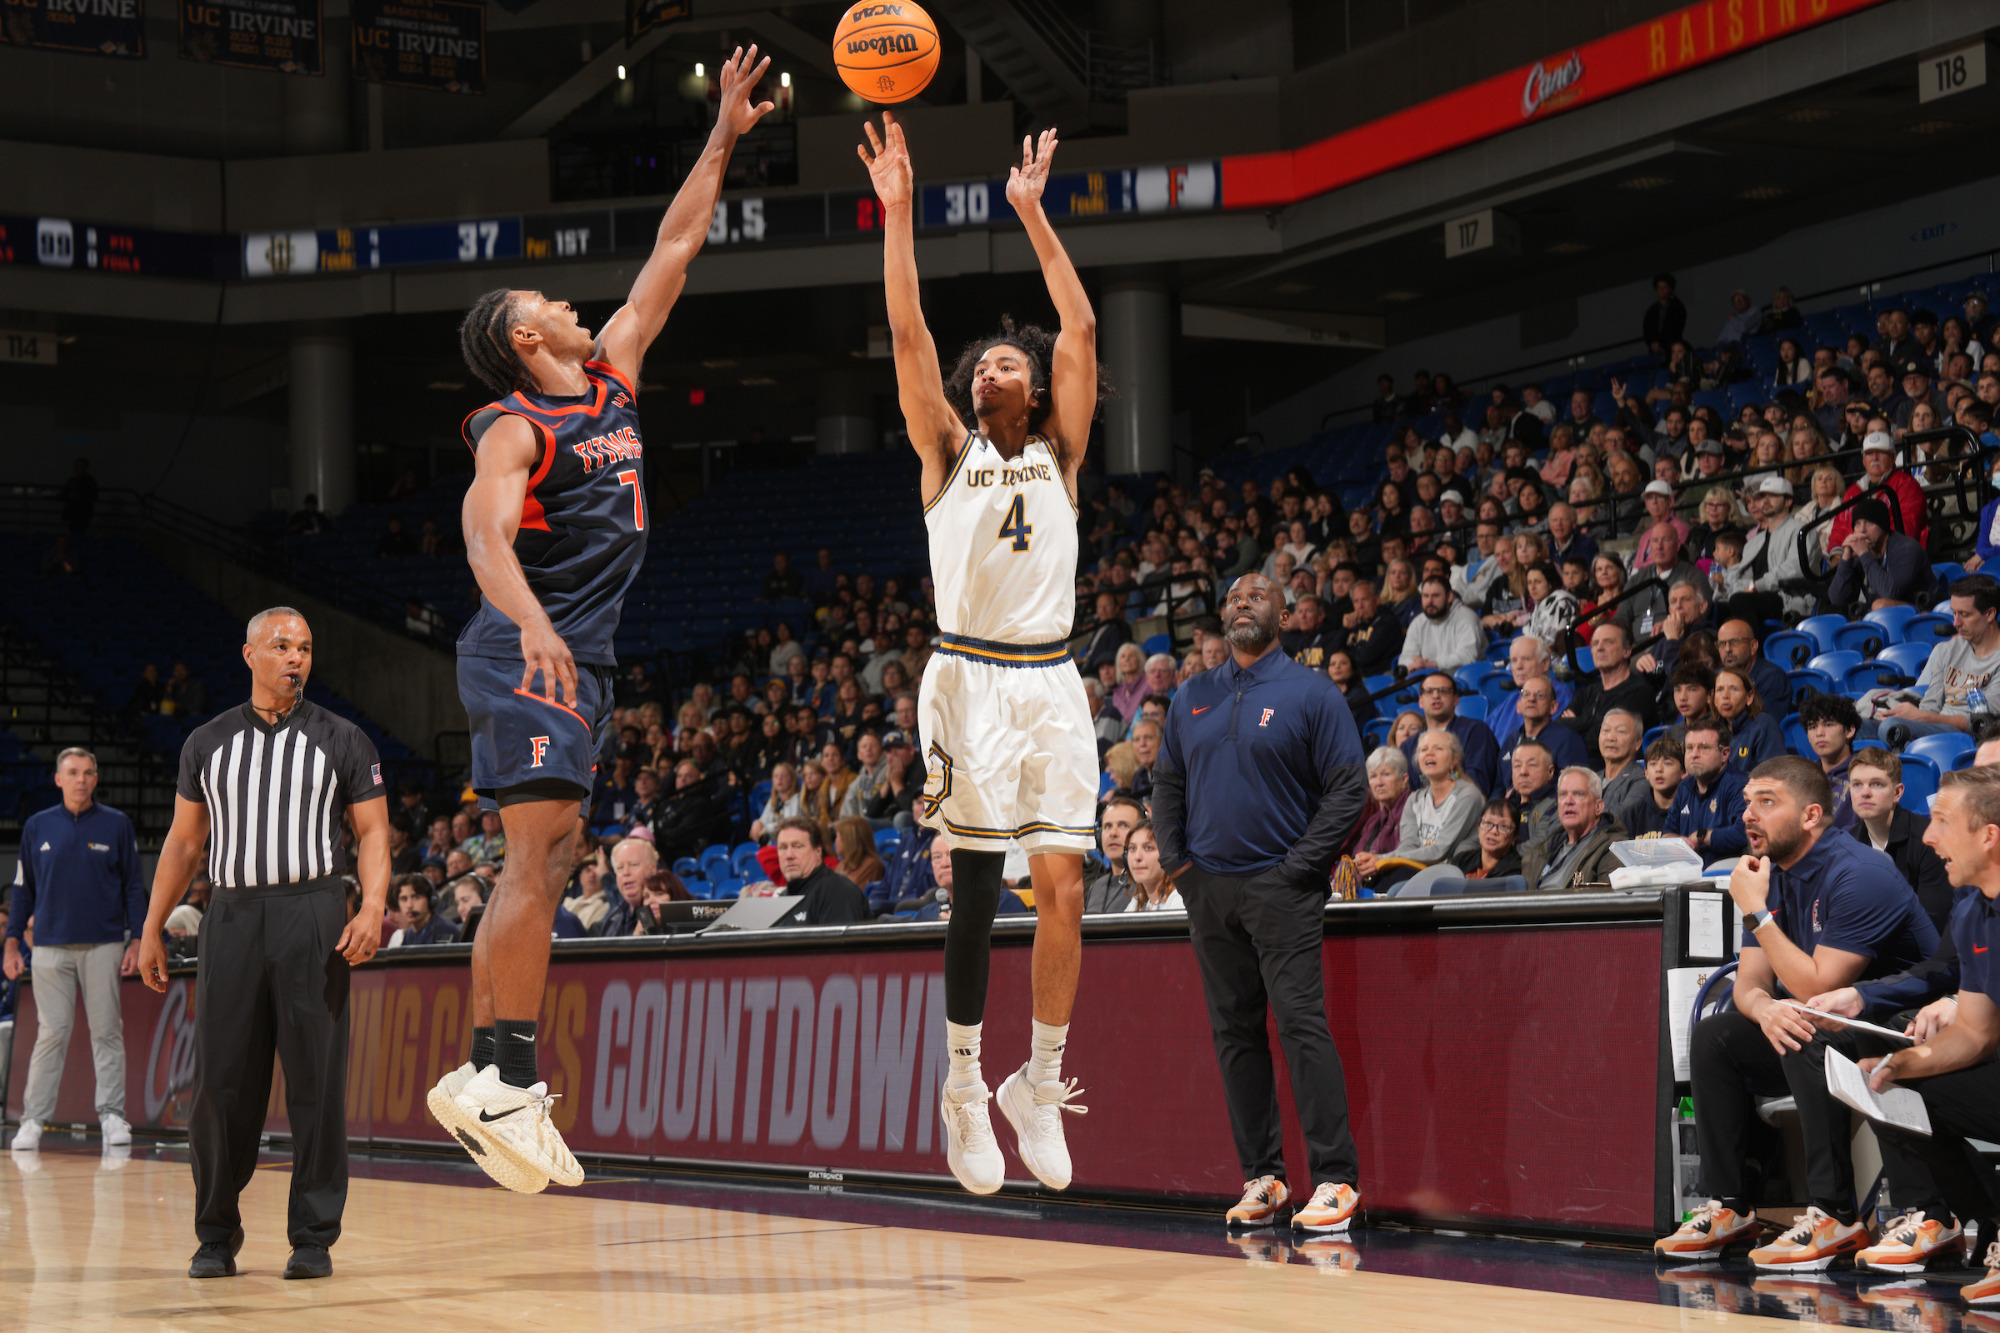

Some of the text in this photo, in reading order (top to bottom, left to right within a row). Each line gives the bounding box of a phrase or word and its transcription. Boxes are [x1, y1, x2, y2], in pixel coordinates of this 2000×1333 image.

[187, 4, 316, 39] UC IRVINE
[853, 4, 903, 23] NCAA
[357, 26, 479, 60] UC IRVINE
[847, 33, 918, 56] Wilson
[1935, 55, 1968, 92] 118
[946, 183, 989, 225] 30
[1168, 166, 1188, 209] F
[458, 222, 499, 261] 37
[1459, 220, 1478, 250] 117
[1922, 223, 1945, 241] EXIT
[8, 335, 38, 359] 114
[573, 426, 643, 474] TITANS
[967, 463, 1052, 488] UC IRVINE
[617, 469, 644, 531] 7
[997, 492, 1033, 553] 4
[1259, 708, 1274, 727] F
[530, 735, 550, 768] F
